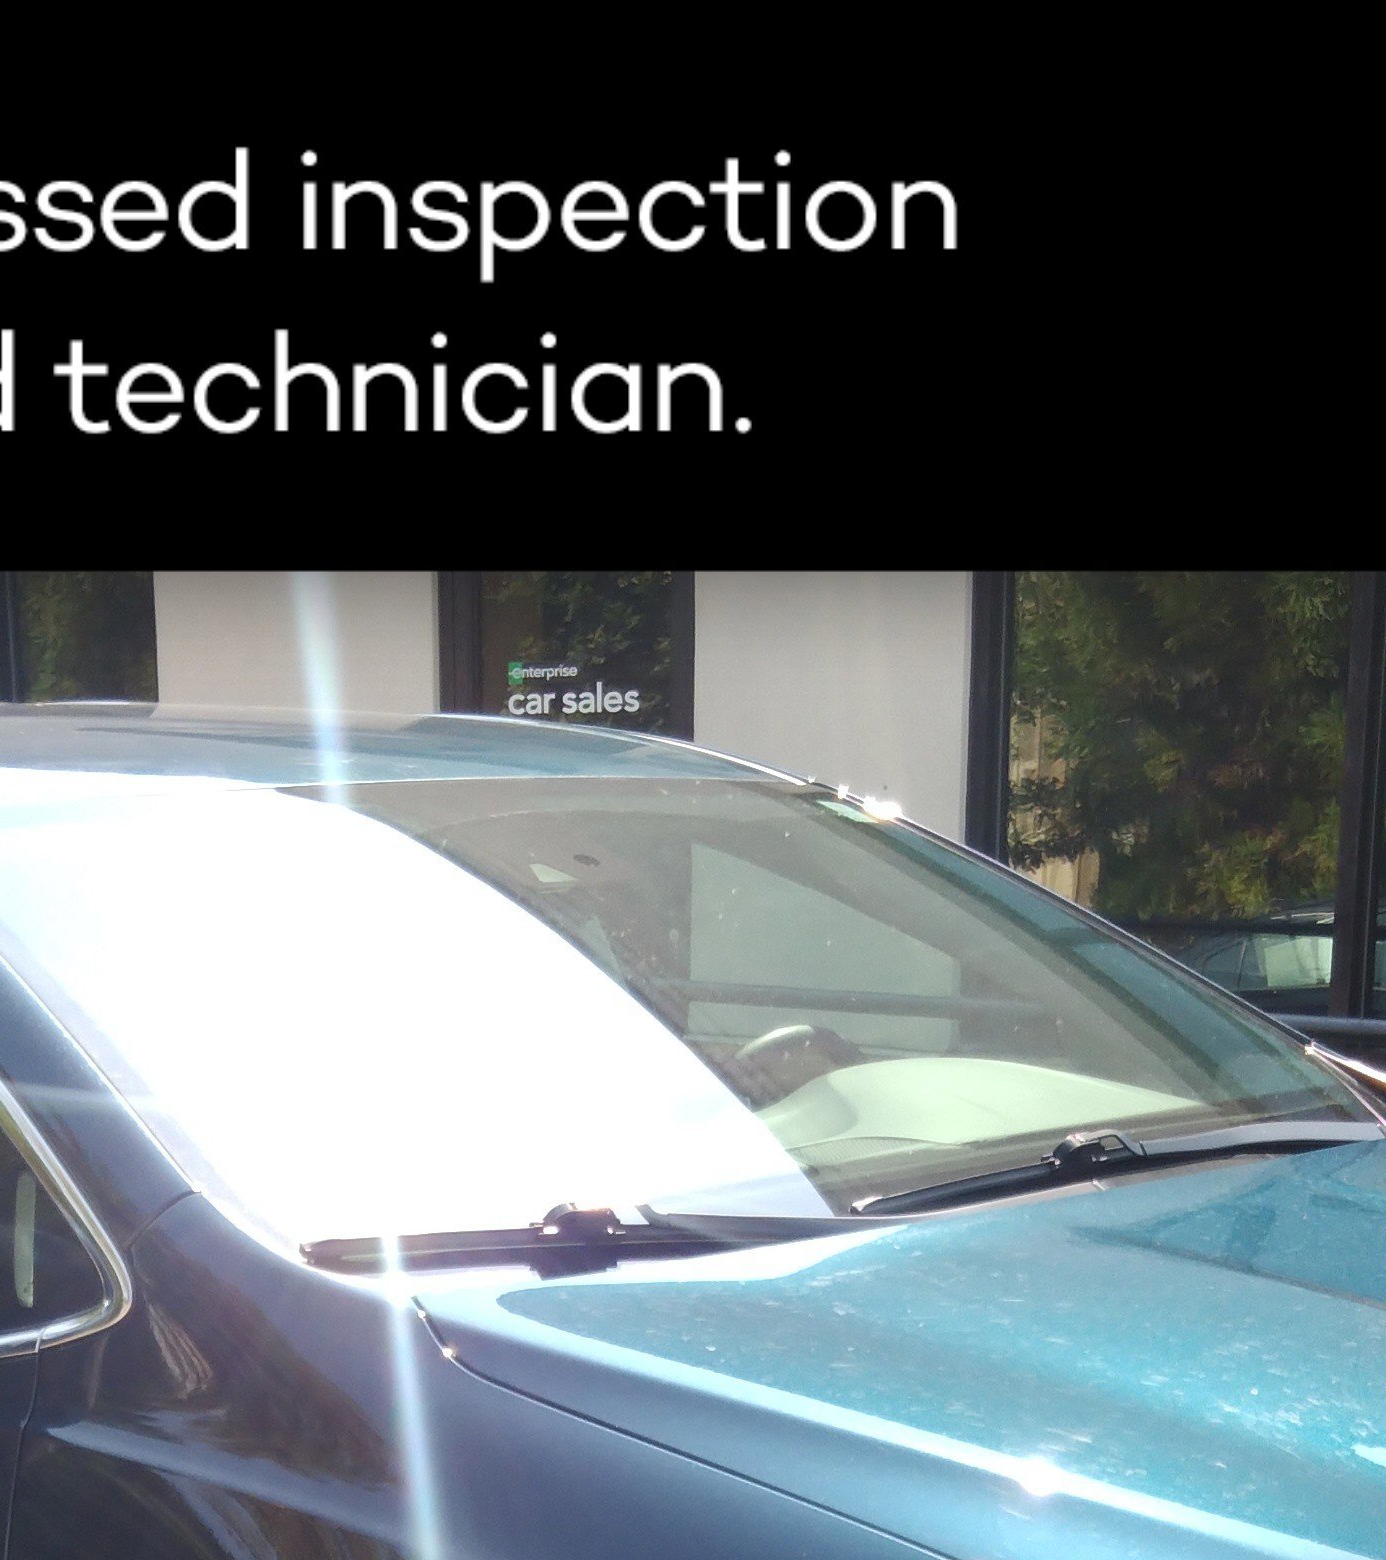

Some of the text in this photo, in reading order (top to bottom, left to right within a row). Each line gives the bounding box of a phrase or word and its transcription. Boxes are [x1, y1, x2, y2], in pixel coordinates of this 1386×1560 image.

[512, 664, 578, 680] enterprise
[508, 681, 640, 715] car sales
